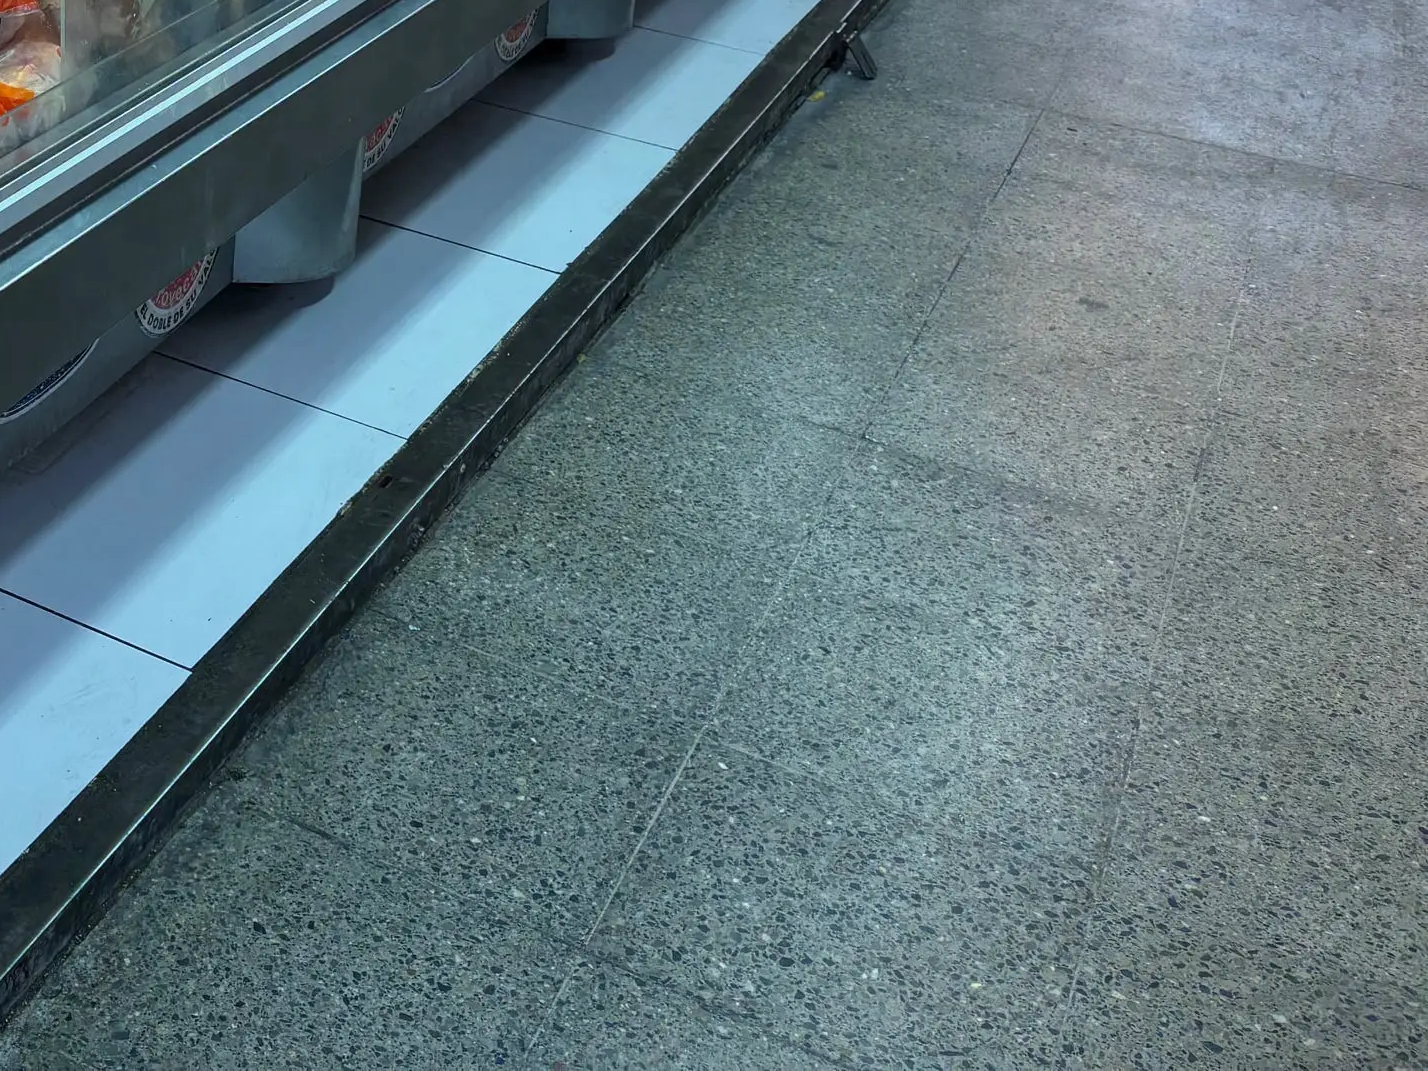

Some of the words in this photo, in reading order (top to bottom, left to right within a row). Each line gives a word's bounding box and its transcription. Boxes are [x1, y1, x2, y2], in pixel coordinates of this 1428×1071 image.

[147, 313, 172, 330] DOBLE
[173, 306, 184, 324] DE
[186, 288, 197, 311] SU
